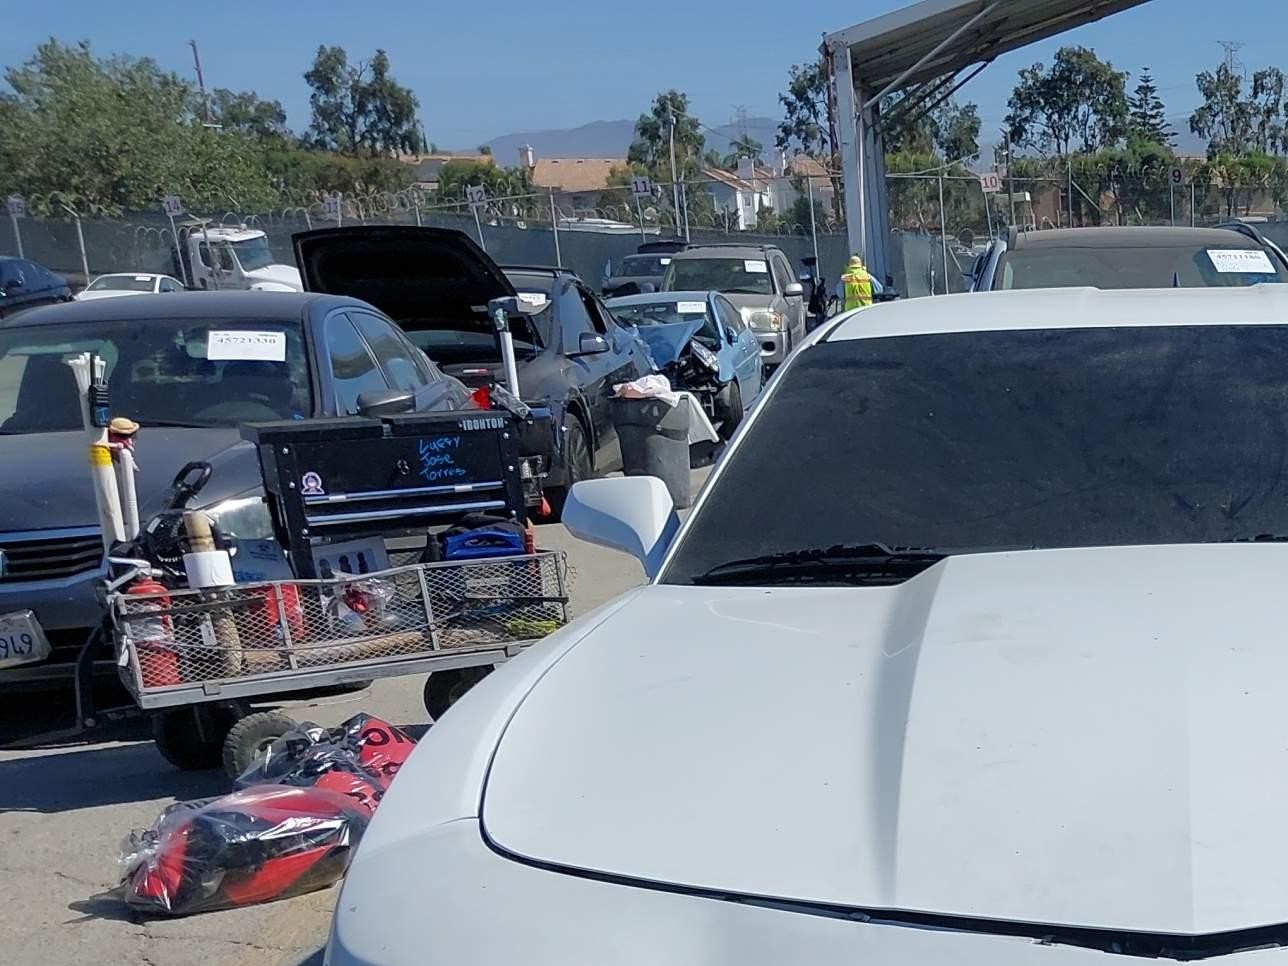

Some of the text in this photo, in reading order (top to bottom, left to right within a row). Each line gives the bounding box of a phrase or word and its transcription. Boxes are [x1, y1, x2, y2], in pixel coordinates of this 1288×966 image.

[982, 176, 998, 188] 10
[1172, 169, 1182, 183] 9
[632, 180, 650, 193] 11
[469, 190, 484, 201] 12
[463, 418, 505, 431] IRONTON
[420, 452, 455, 467] Jose
[420, 467, 467, 481] Torres
